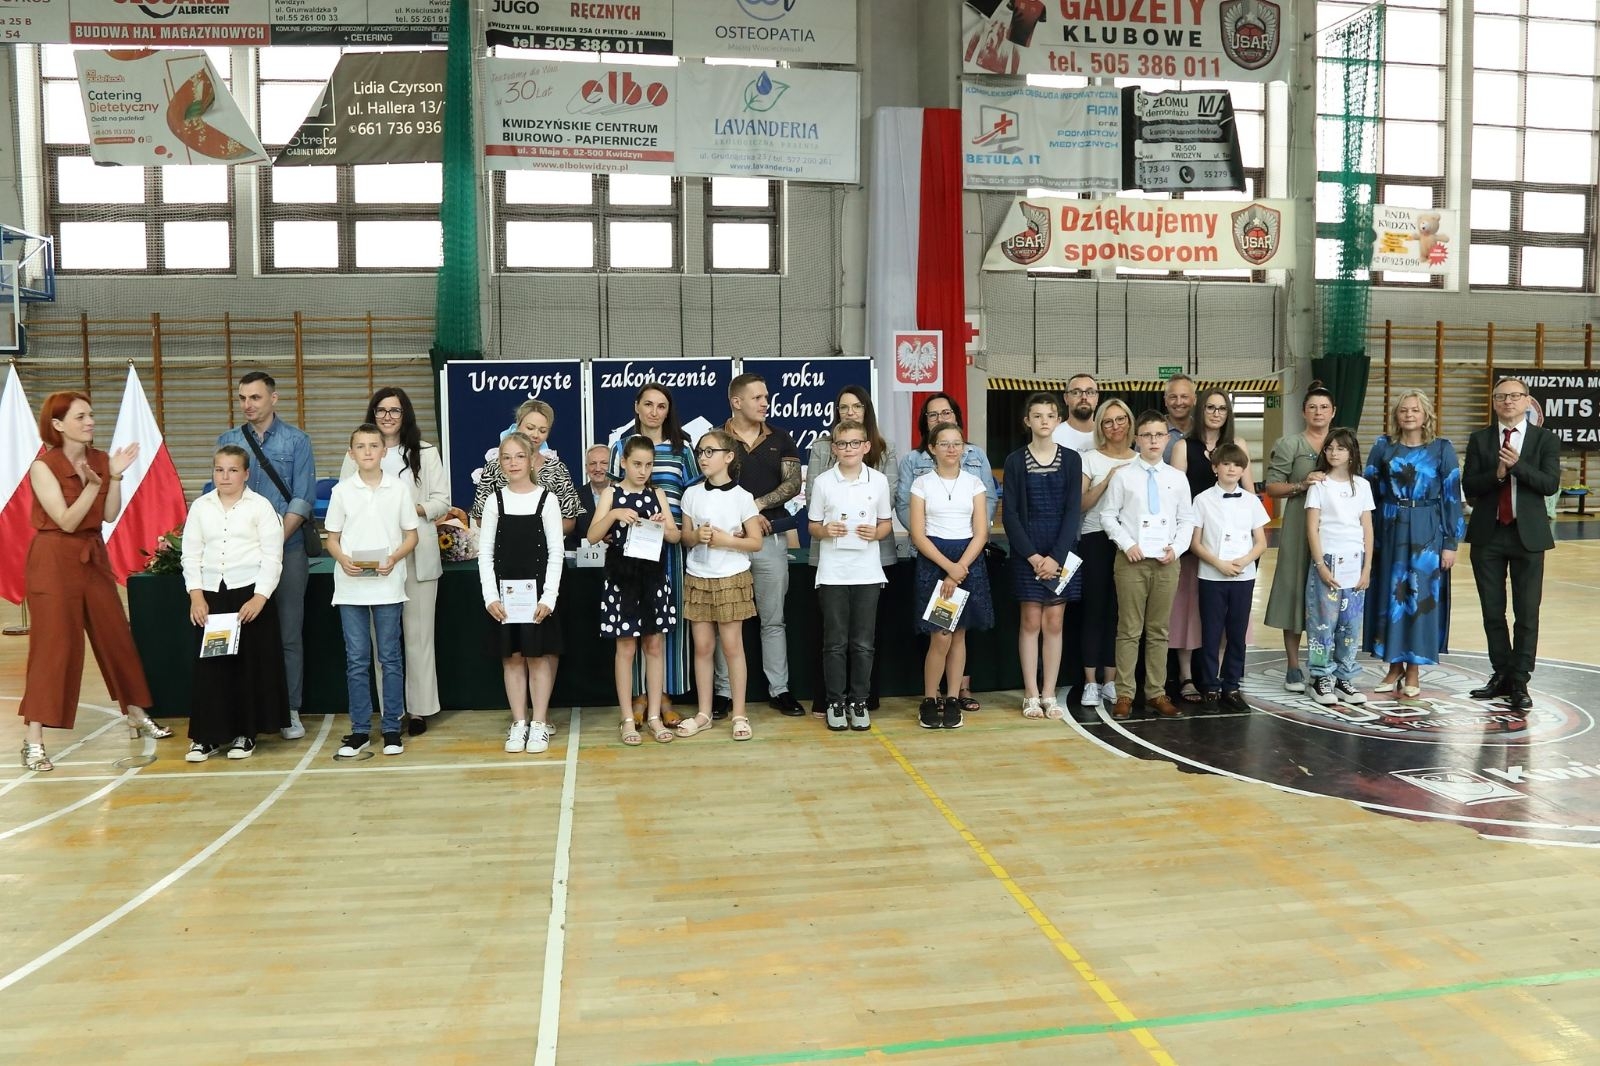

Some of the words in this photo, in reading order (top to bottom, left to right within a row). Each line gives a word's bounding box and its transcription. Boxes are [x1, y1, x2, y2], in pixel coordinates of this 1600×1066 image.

[177, 5, 230, 15] ALBRECHT
[492, 0, 540, 14] JUGO
[570, 2, 641, 21] RĘCZNYCH
[9, 17, 22, 26] 25
[300, 14, 314, 22] 261
[422, 15, 436, 23] 261
[5, 30, 21, 39] 54
[75, 24, 130, 39] BUDOWA
[133, 26, 157, 39] HAL
[160, 26, 265, 40] MAGAZYNOWYCH
[487, 22, 521, 31] KWIDZYN
[522, 24, 534, 32] UL.
[535, 25, 577, 33] KOPERNIKA
[602, 29, 628, 37] PIĘTRO
[715, 25, 816, 42] OSTEOPATIA
[1063, 25, 1202, 47] KLUBOWE
[350, 34, 393, 42] CETERING
[512, 35, 540, 48] tel.
[545, 37, 576, 50] 505
[580, 39, 611, 52] 386
[615, 40, 645, 53] 011
[1230, 31, 1271, 51] USAR
[1048, 51, 1083, 73] tel.
[1090, 52, 1130, 74] 505
[1137, 54, 1177, 77] 386
[1183, 56, 1220, 78] 011
[353, 81, 385, 95] Lidia
[389, 80, 443, 97] Czyrson
[505, 79, 537, 104] 30
[581, 71, 669, 107] elbo
[88, 90, 142, 103] Catering
[1152, 96, 1188, 109] ZŁOMU
[89, 102, 159, 114] Dietetyczny
[347, 102, 364, 115] ul.
[367, 101, 415, 114] Hallera
[1086, 104, 1119, 116] FIRM
[358, 122, 382, 135] 661
[387, 121, 413, 135] 736
[416, 121, 442, 134] 936
[502, 117, 591, 131] KWIDZYŃSKIE
[595, 121, 658, 134] CENTRUM
[714, 118, 820, 139] LAVANDERIA
[502, 132, 563, 143] BIUROWO
[575, 134, 657, 147] PAPIERNICZE
[1049, 140, 1119, 148] MEDYCZNYCH
[517, 147, 528, 155] ul.
[531, 147, 537, 155] 3
[539, 147, 560, 157] Maja
[573, 149, 604, 157] 82-500
[606, 150, 643, 159] Kwidzyn
[966, 153, 1023, 166] BETULA
[1029, 155, 1041, 165] IT
[532, 161, 629, 172] www.elbokwidzyn.pl
[729, 163, 804, 174] www.lavanderia.pl
[1060, 205, 1219, 239] Dziękujemy
[1007, 233, 1045, 249] USAR
[1241, 234, 1273, 249] USAR
[1064, 243, 1218, 266] sponsorom
[600, 361, 718, 389] zakończenie
[781, 362, 826, 388] roku
[467, 370, 573, 400] Uroczyste
[767, 393, 835, 427] kolneg
[1545, 398, 1593, 418] MTS
[1576, 429, 1600, 442] ZA
